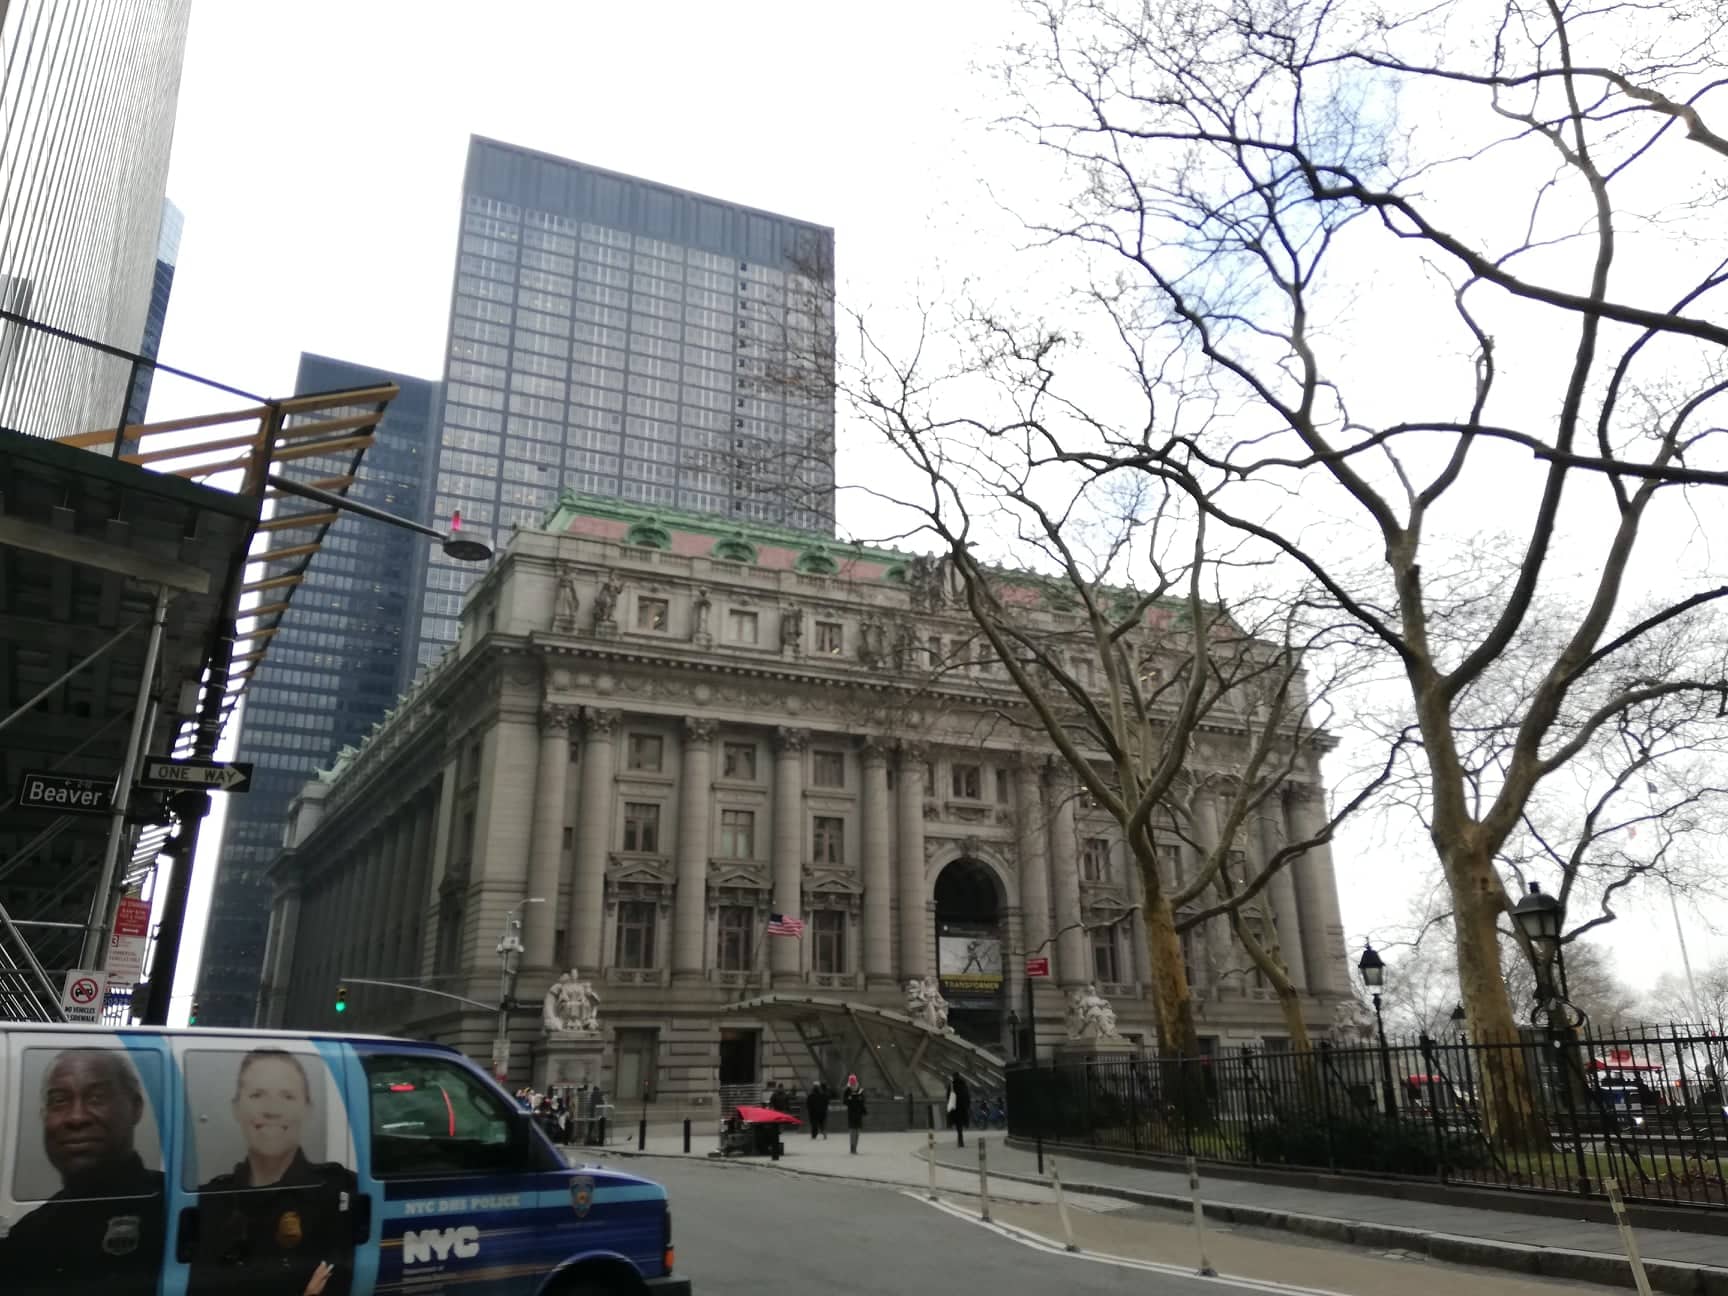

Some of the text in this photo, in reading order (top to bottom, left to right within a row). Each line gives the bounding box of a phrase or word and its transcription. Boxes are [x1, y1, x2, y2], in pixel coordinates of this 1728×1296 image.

[158, 766, 236, 783] ONE WAY
[29, 781, 103, 805] Beaver
[69, 1014, 96, 1022] SIDEWALK
[73, 1006, 96, 1014] VEHICLES
[405, 1200, 434, 1215] NYC
[472, 1195, 520, 1209] POLICE
[403, 1225, 480, 1265] NYC
